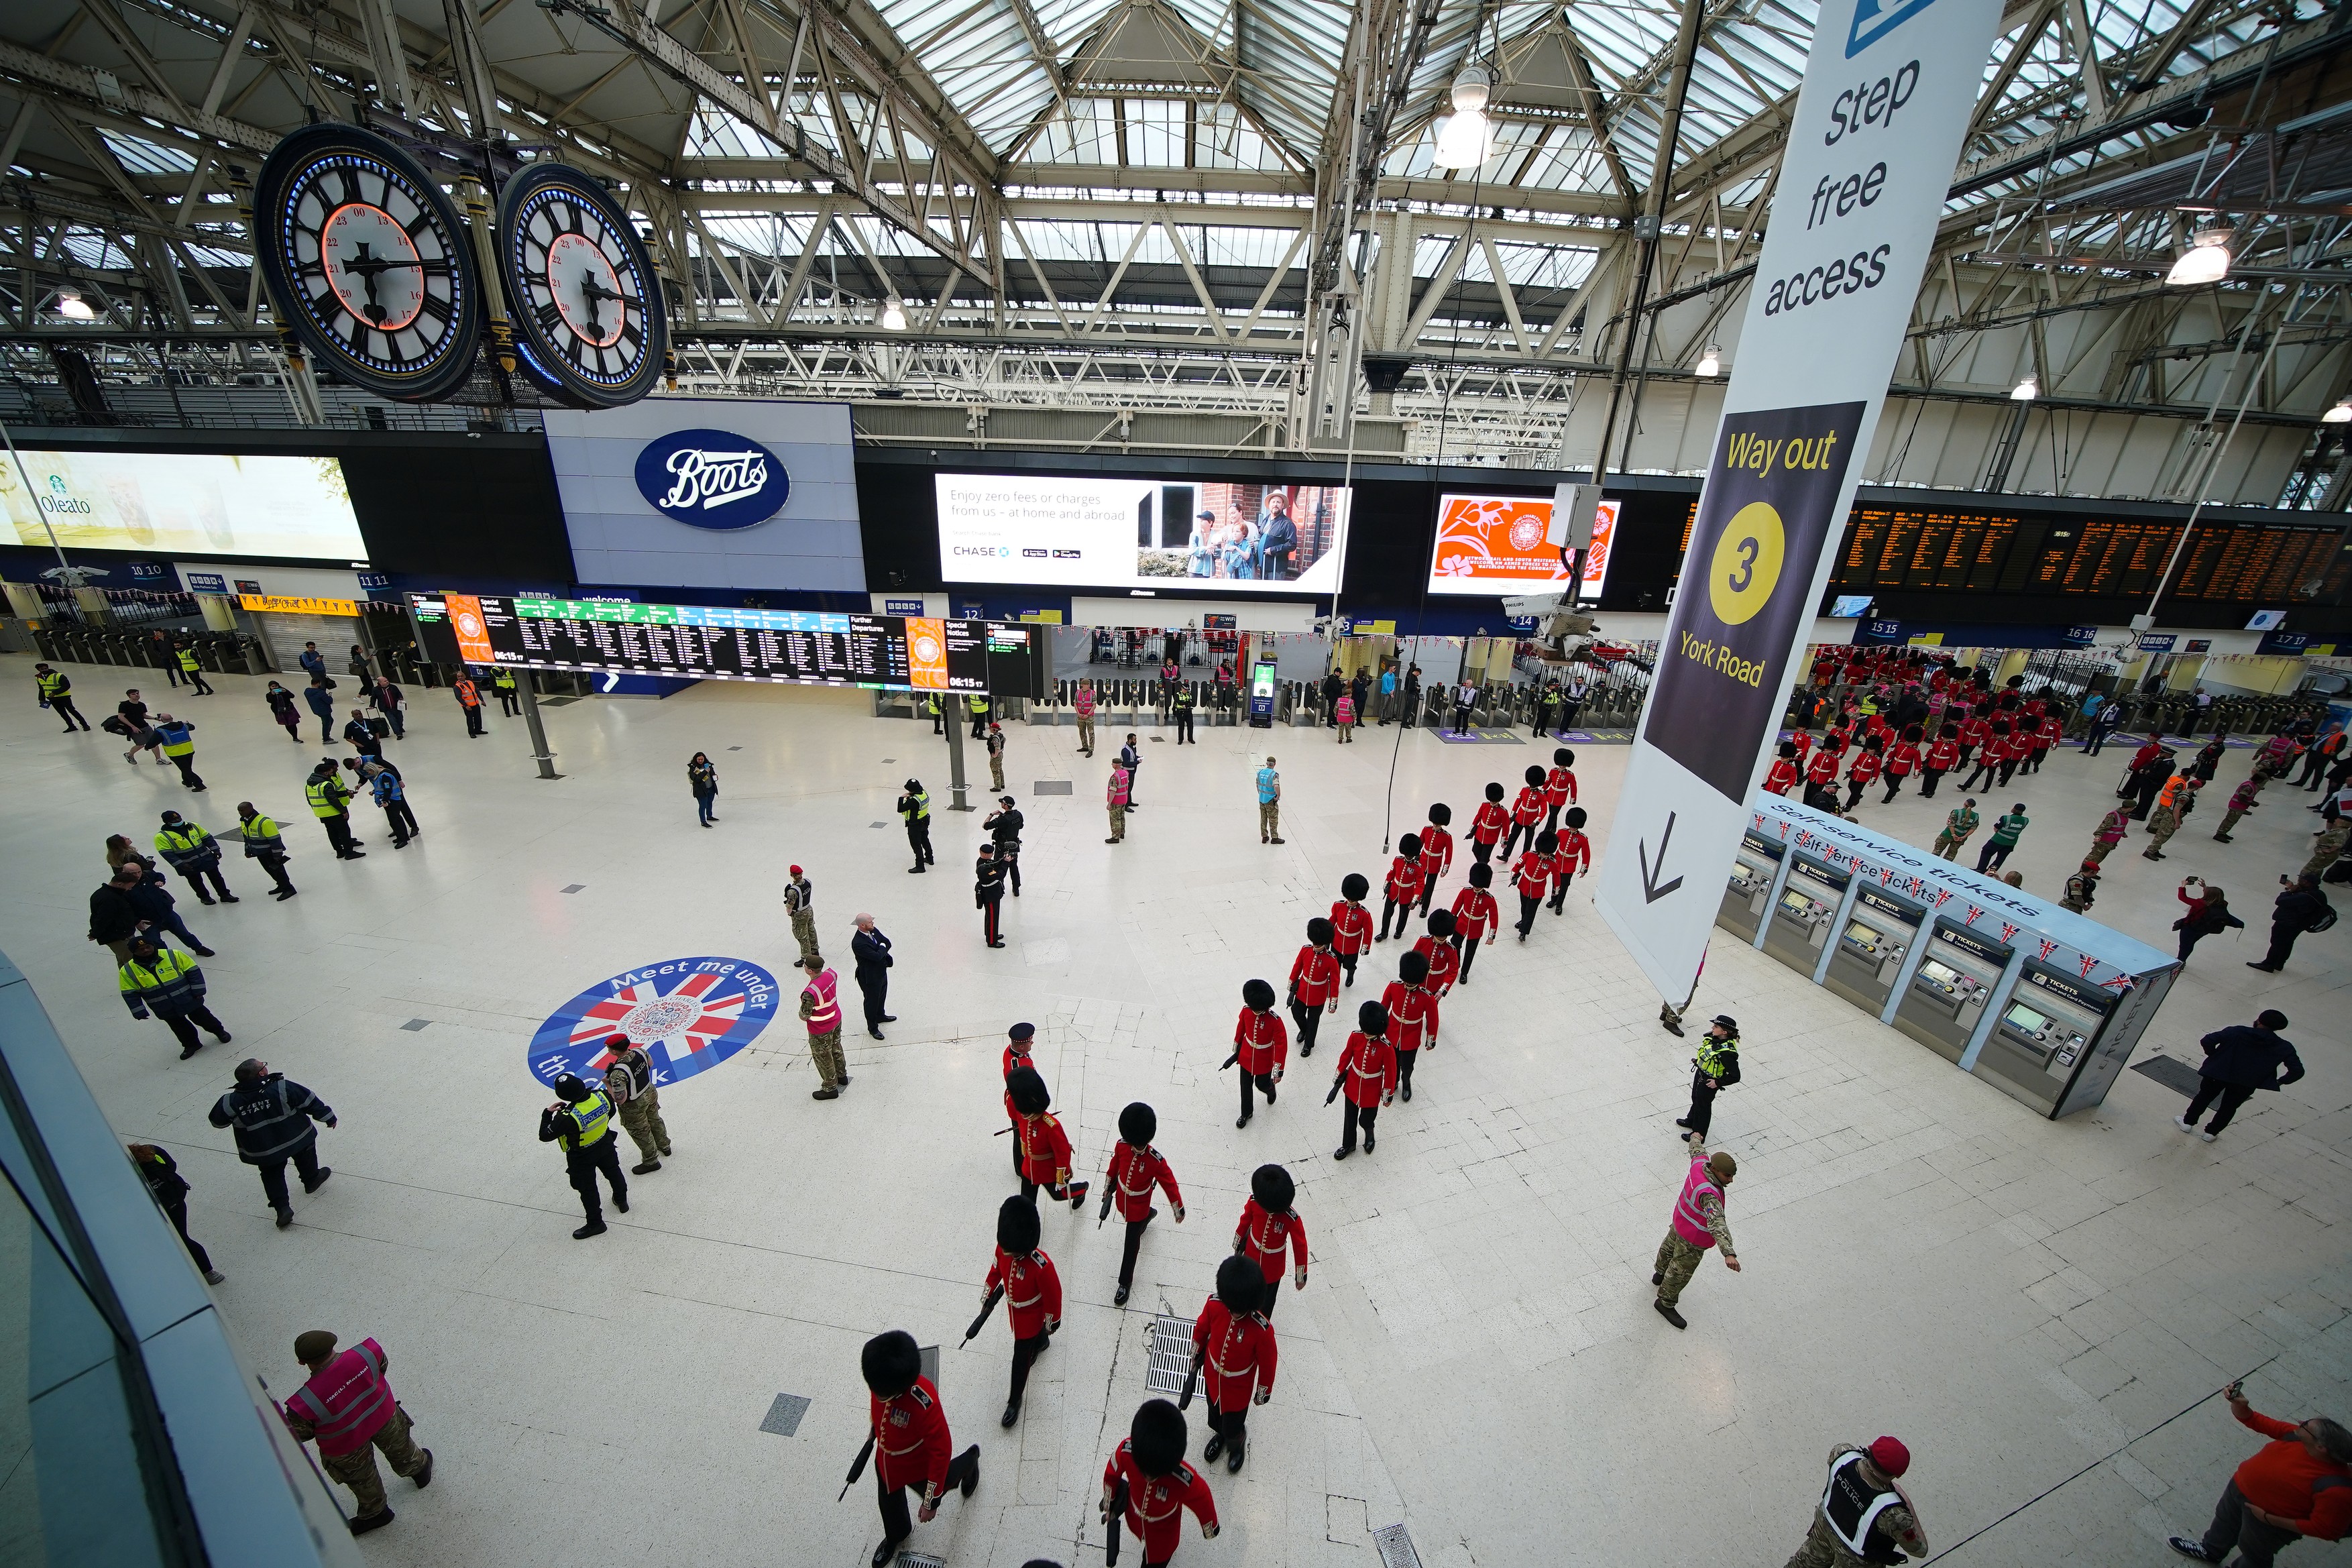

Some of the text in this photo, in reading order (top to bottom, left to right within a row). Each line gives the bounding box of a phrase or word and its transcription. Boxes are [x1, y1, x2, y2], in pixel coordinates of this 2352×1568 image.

[1825, 60, 1919, 146] Step
[1806, 162, 1887, 231] free
[353, 208, 366, 217] 00
[335, 217, 347, 225] 23
[377, 215, 389, 225] 13
[327, 238, 338, 247] 22
[397, 236, 409, 246] 14
[561, 239, 570, 249] 23
[575, 237, 584, 247] 00
[592, 249, 601, 259] 13
[552, 255, 561, 264] 22
[328, 264, 339, 273] 21
[606, 271, 614, 280] 14
[1765, 244, 1891, 317] access
[552, 278, 561, 288] 21
[340, 289, 351, 298] 20
[410, 290, 421, 300] 16
[561, 303, 570, 312] 20
[401, 310, 412, 319] 17
[614, 317, 622, 325] 16
[575, 323, 583, 331] 19
[607, 331, 614, 339] 17
[1728, 430, 1837, 478] Way out
[659, 449, 768, 510] Boots
[951, 490, 1101, 506] Enjoy zero fees or charges
[41, 495, 91, 514] Oleato
[952, 506, 1125, 520] from us at home and abroad
[954, 547, 995, 556] CHASE
[146, 565, 162, 575] 10
[1729, 537, 1758, 593] 3
[131, 566, 143, 575] 10
[359, 576, 372, 585] 11
[374, 575, 389, 585] 11
[964, 610, 978, 619] 12
[1510, 616, 1516, 624] 14
[1519, 616, 1532, 625] 14
[851, 624, 884, 632] Departures
[1871, 622, 1883, 632] 15
[1885, 624, 1898, 634] 15
[2067, 628, 2082, 638] 16
[2083, 630, 2094, 639] 16
[2276, 634, 2294, 643] 17
[2294, 636, 2306, 645] 17
[1226, 642, 1236, 650] 13
[494, 651, 516, 661] 06:15
[1681, 630, 1766, 688] York Road
[950, 677, 974, 687] 06:15
[1745, 837, 1763, 848] TICKETS
[1750, 844, 1765, 854] Payments
[1771, 805, 2040, 917] Self-service tickets
[1809, 866, 1828, 879] TICKETS
[1815, 874, 1829, 884] Payments
[803, 887, 811, 896] POLICE
[1877, 899, 1899, 911] TICKETS
[1885, 907, 1901, 917] Payments
[1956, 934, 1982, 950] TICKETS
[1954, 941, 1983, 957] Card Payments
[611, 960, 775, 1010] Meet me under
[2050, 978, 2078, 995] TICKETS
[645, 998, 667, 1007] KING
[669, 997, 699, 1008] CHARLES
[2046, 984, 2102, 1013] Cash and Card Payments
[662, 1029, 680, 1039] MAY
[681, 1017, 696, 1029] 2023
[2105, 988, 2149, 1058] TICKETS
[634, 1062, 647, 1077] POLICE
[239, 1099, 270, 1111] EVENT
[241, 1104, 271, 1116] STAFF
[583, 1106, 607, 1125] POLICE
[326, 1365, 369, 1404] JMC(L) Marshal
[1837, 1474, 1864, 1511] POLICE
[1844, 1477, 1860, 1498] MILITARY
